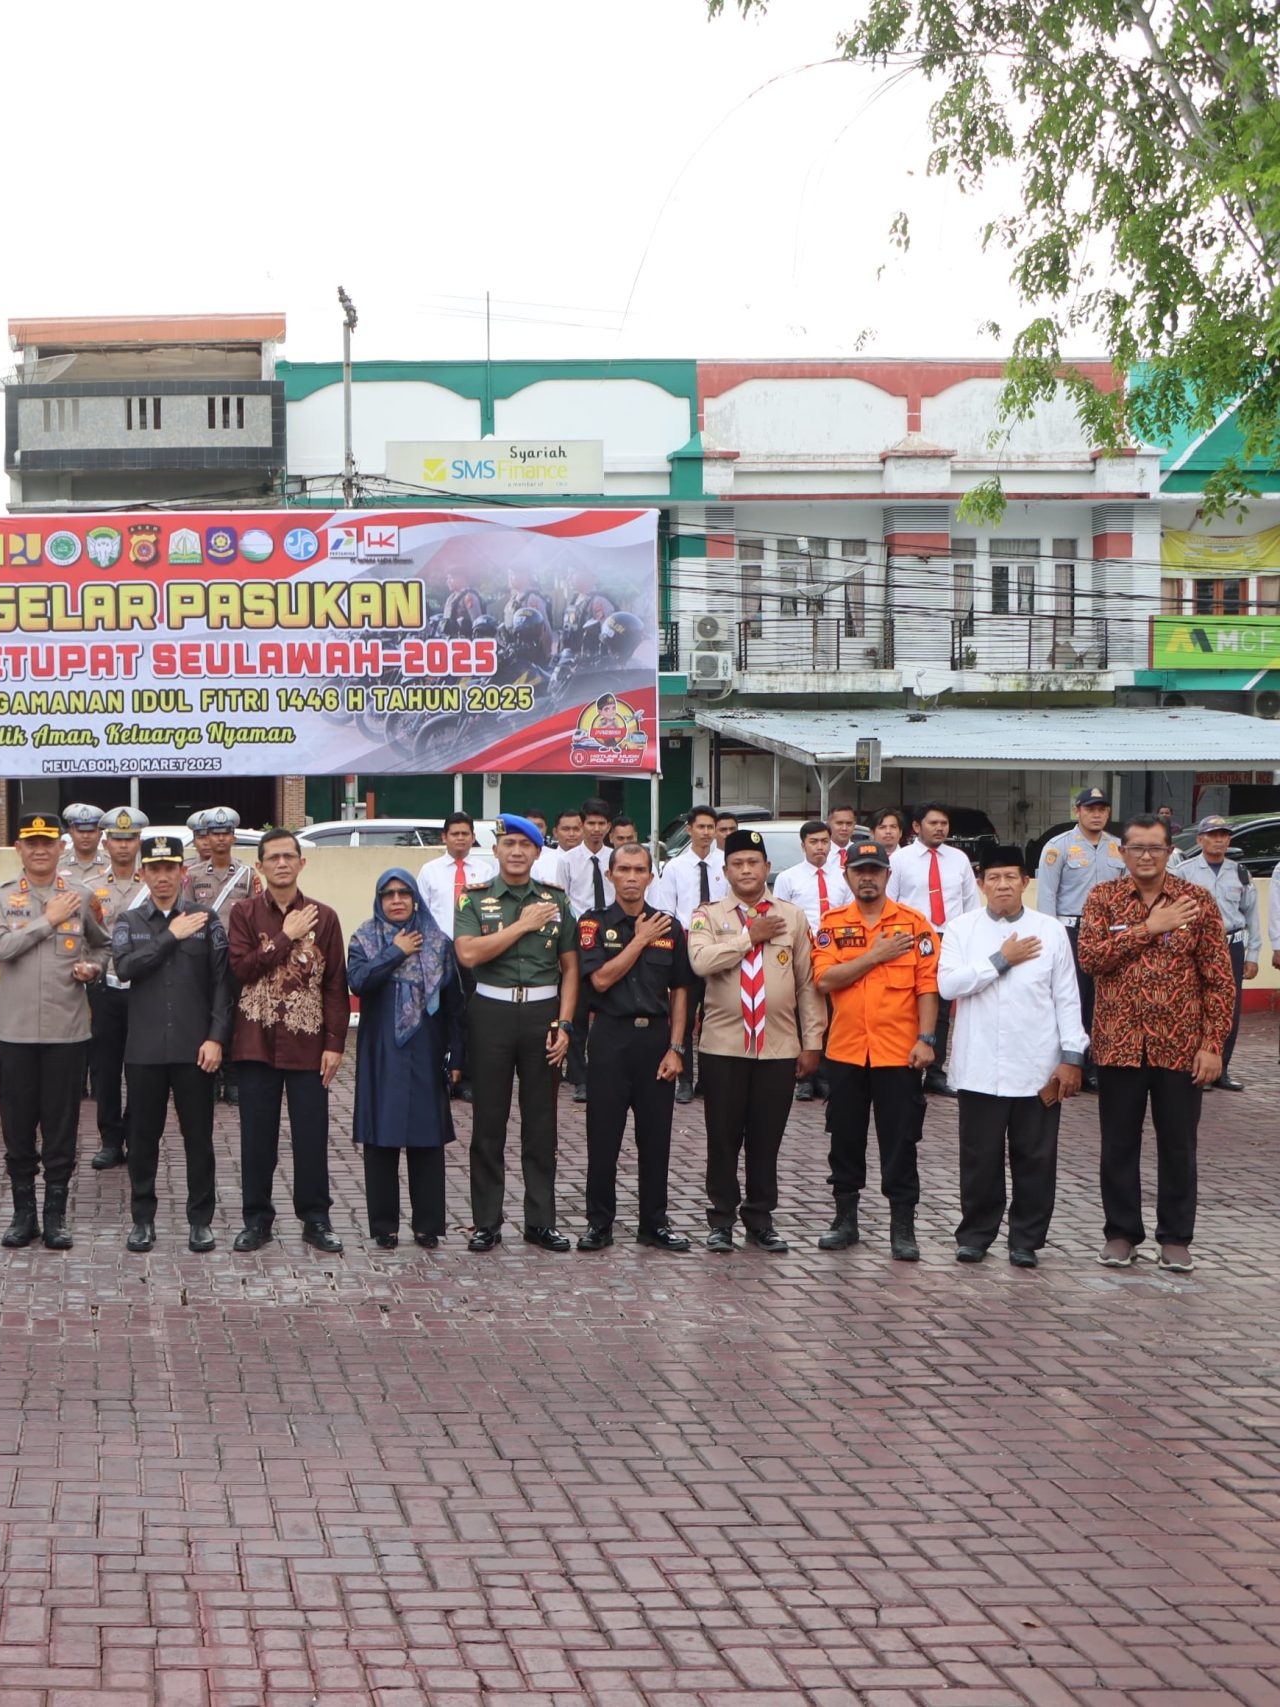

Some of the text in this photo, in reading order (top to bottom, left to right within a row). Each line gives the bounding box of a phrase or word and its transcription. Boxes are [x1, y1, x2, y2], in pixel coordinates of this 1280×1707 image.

[509, 445, 568, 463] Syariah
[451, 460, 568, 480] SMS Finance
[167, 581, 424, 629] PASUKAN
[1216, 629, 1277, 653] MCF
[152, 641, 495, 676] SEULAWAH-2025
[132, 689, 192, 713] IDUL
[200, 688, 269, 713] FITRI
[276, 688, 339, 711] 1446
[347, 688, 364, 711] H
[372, 687, 460, 711] TAHUN
[467, 686, 533, 710] 2025
[33, 723, 99, 748] Aman,
[105, 721, 201, 749] Keluarga
[207, 720, 295, 748] Nyaman
[43, 758, 221, 773] MEULABOH, 20 MARET 2025
